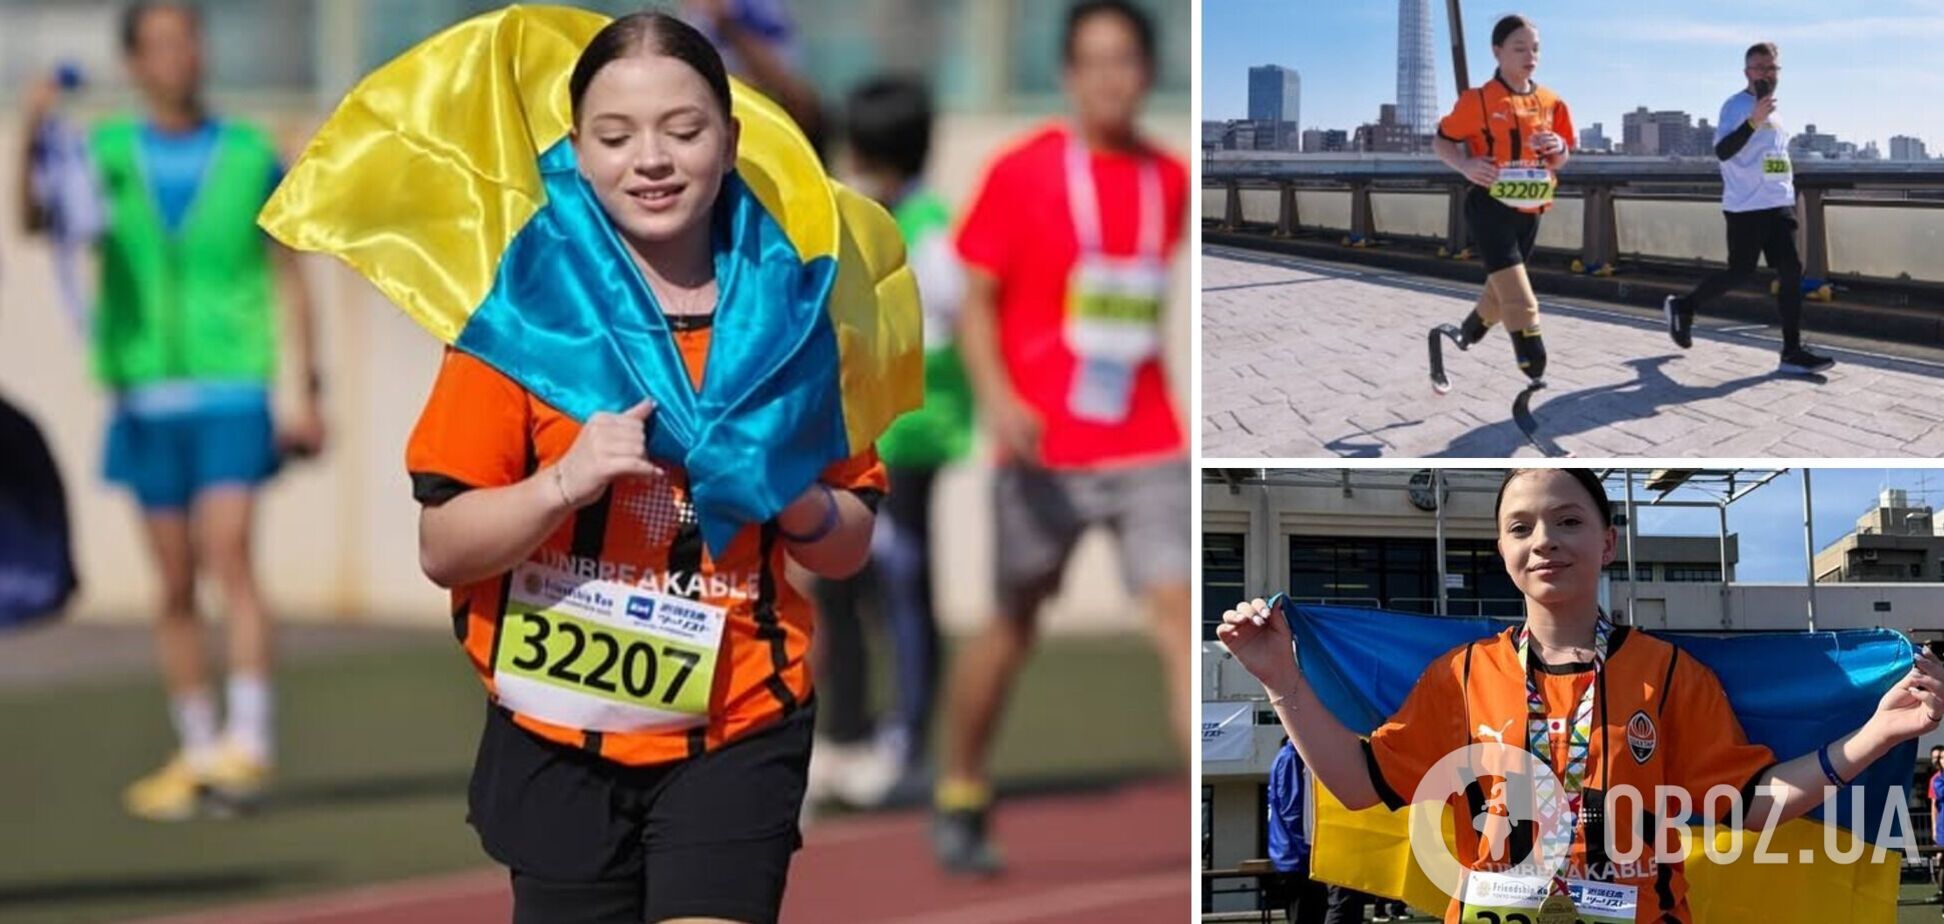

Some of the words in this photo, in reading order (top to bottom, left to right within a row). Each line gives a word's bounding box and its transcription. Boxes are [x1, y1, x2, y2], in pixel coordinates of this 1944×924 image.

[1494, 182, 1550, 199] 32207
[513, 613, 700, 704] 32207
[1493, 881, 1535, 895] Friendship
